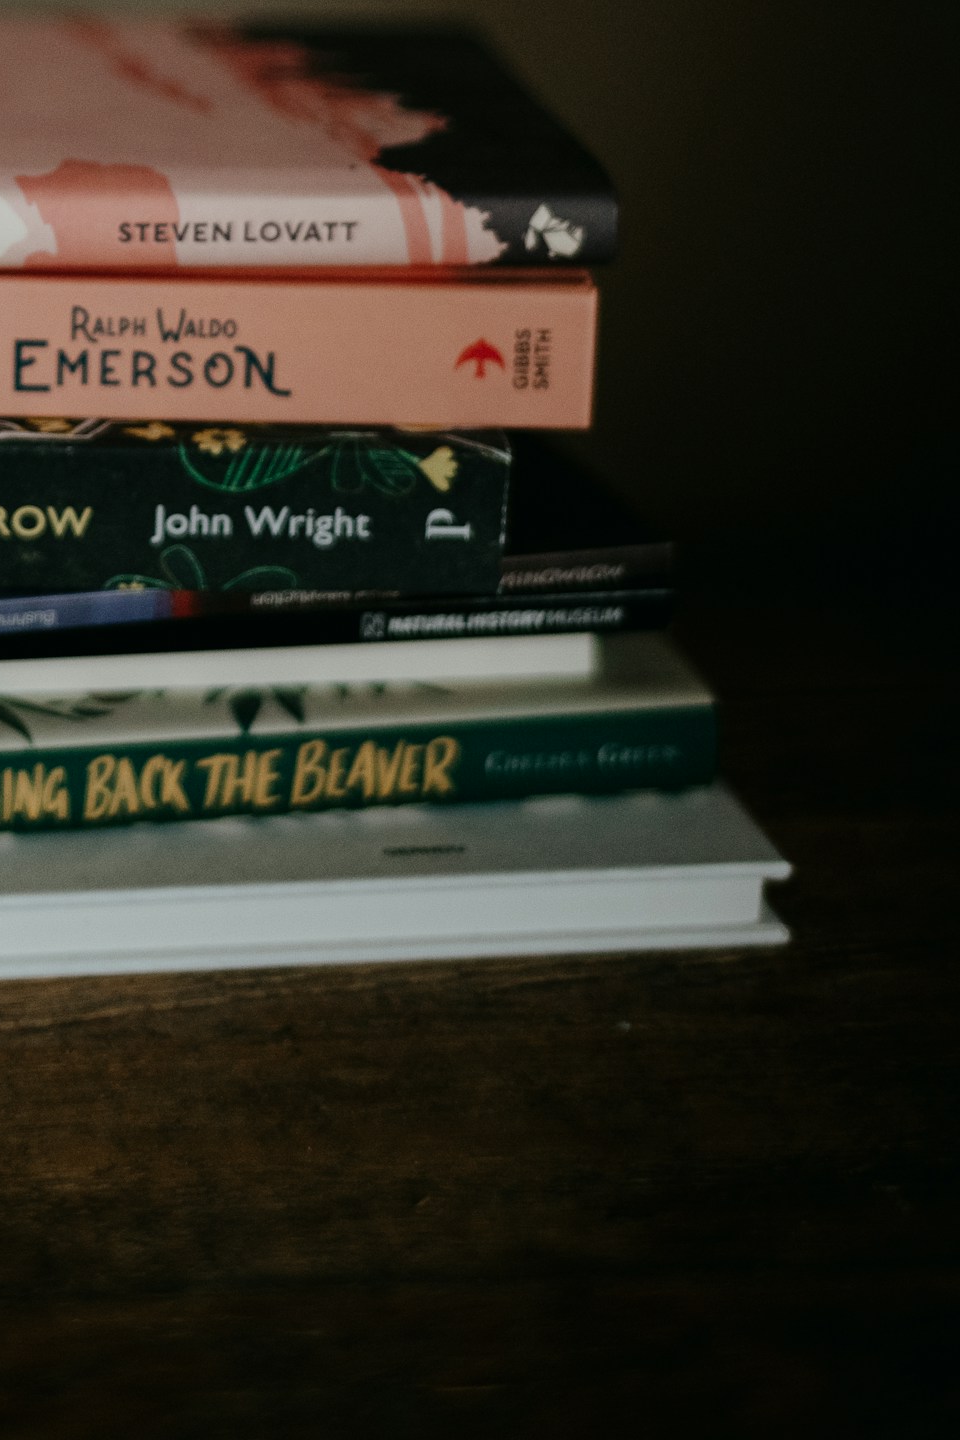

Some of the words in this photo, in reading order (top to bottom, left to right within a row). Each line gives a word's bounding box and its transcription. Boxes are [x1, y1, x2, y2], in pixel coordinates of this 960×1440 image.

[118, 222, 232, 242] STEVEN
[243, 222, 359, 242] LOVATT
[71, 306, 147, 342] RALPH
[157, 308, 237, 343] WALDO
[13, 339, 291, 397] EMERSON
[513, 328, 532, 390] GIBBS
[532, 328, 551, 390] SMITH
[149, 504, 234, 547] John
[244, 505, 373, 550] Wright
[387, 613, 466, 637] NATURAL
[81, 753, 192, 818] BACK
[195, 746, 288, 810] THE
[289, 734, 463, 808] BEAVER
